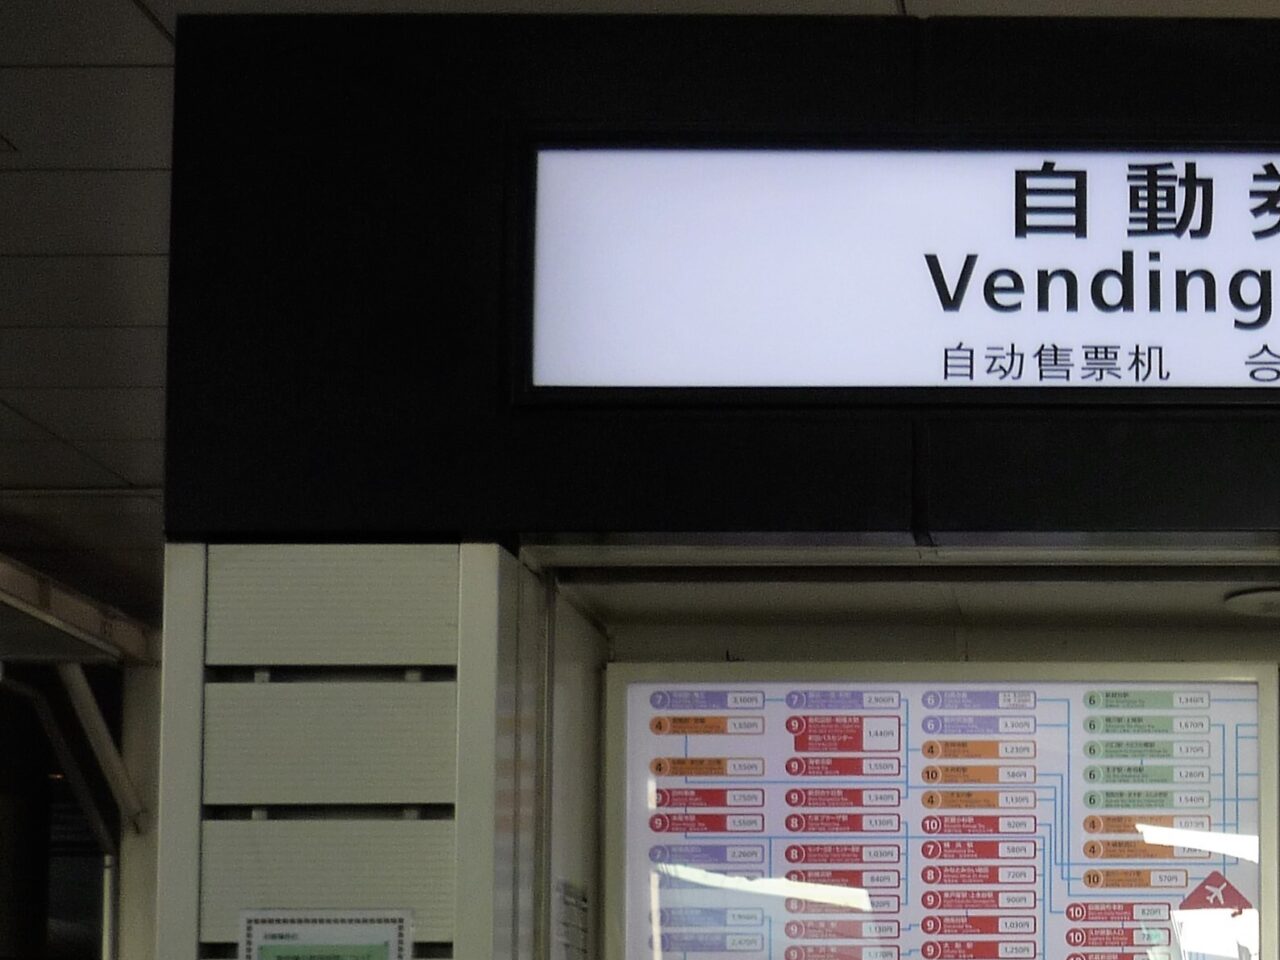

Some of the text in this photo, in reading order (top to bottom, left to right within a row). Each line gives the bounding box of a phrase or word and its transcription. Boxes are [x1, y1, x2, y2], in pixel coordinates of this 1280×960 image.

[923, 251, 1274, 330] Vending
[942, 343, 1170, 382] 自动售票机
